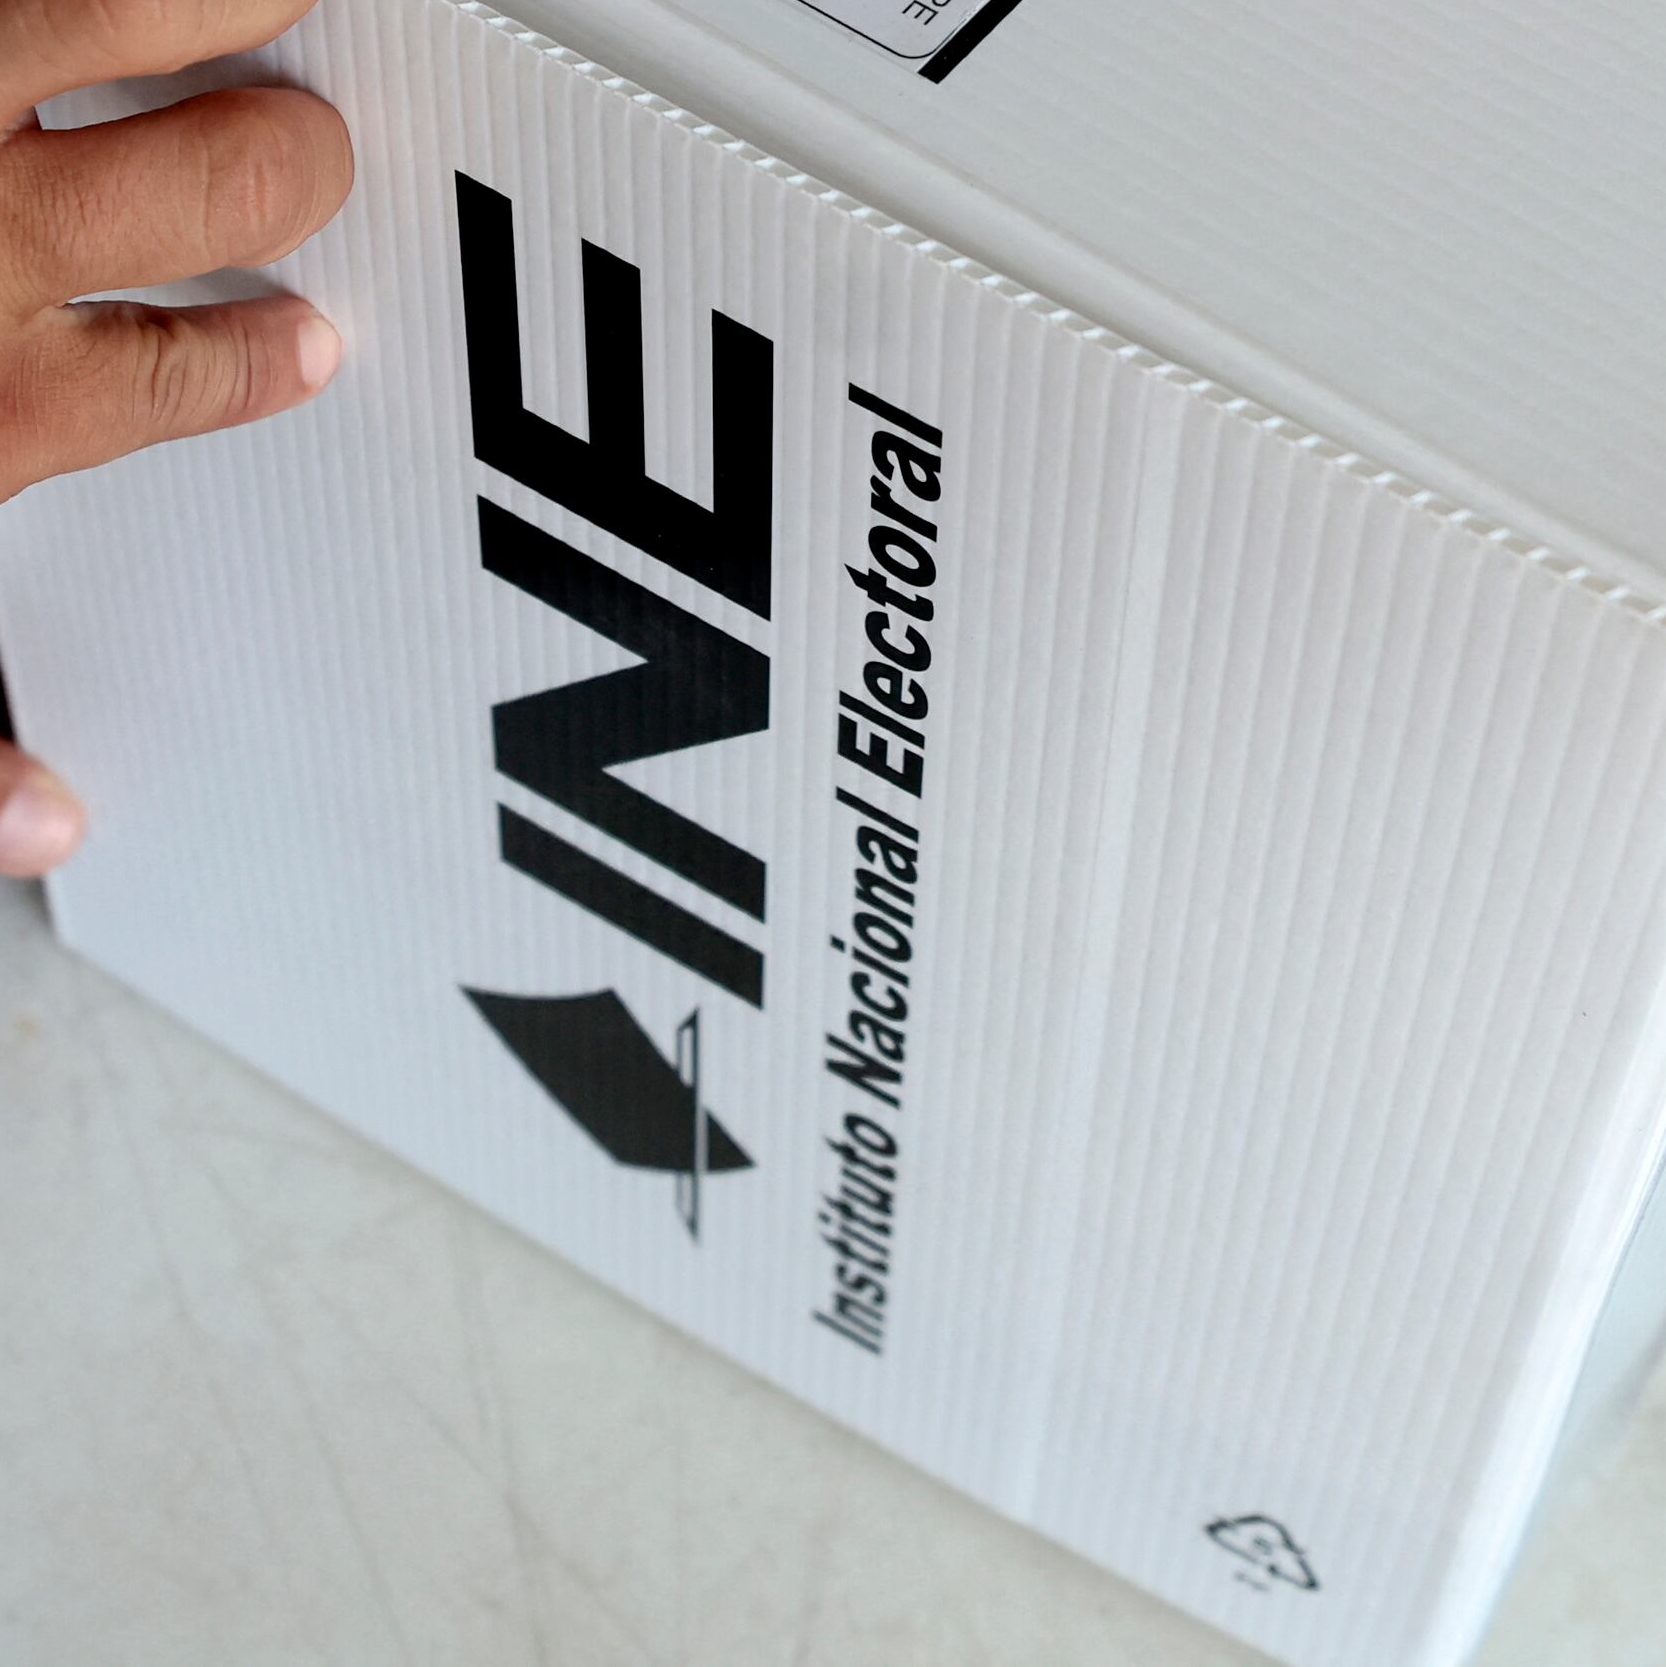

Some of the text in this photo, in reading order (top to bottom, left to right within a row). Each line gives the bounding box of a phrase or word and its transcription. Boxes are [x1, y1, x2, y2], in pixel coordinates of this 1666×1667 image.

[455, 170, 774, 1009] INE
[812, 381, 944, 1355] Instituto Nacional Electoral
